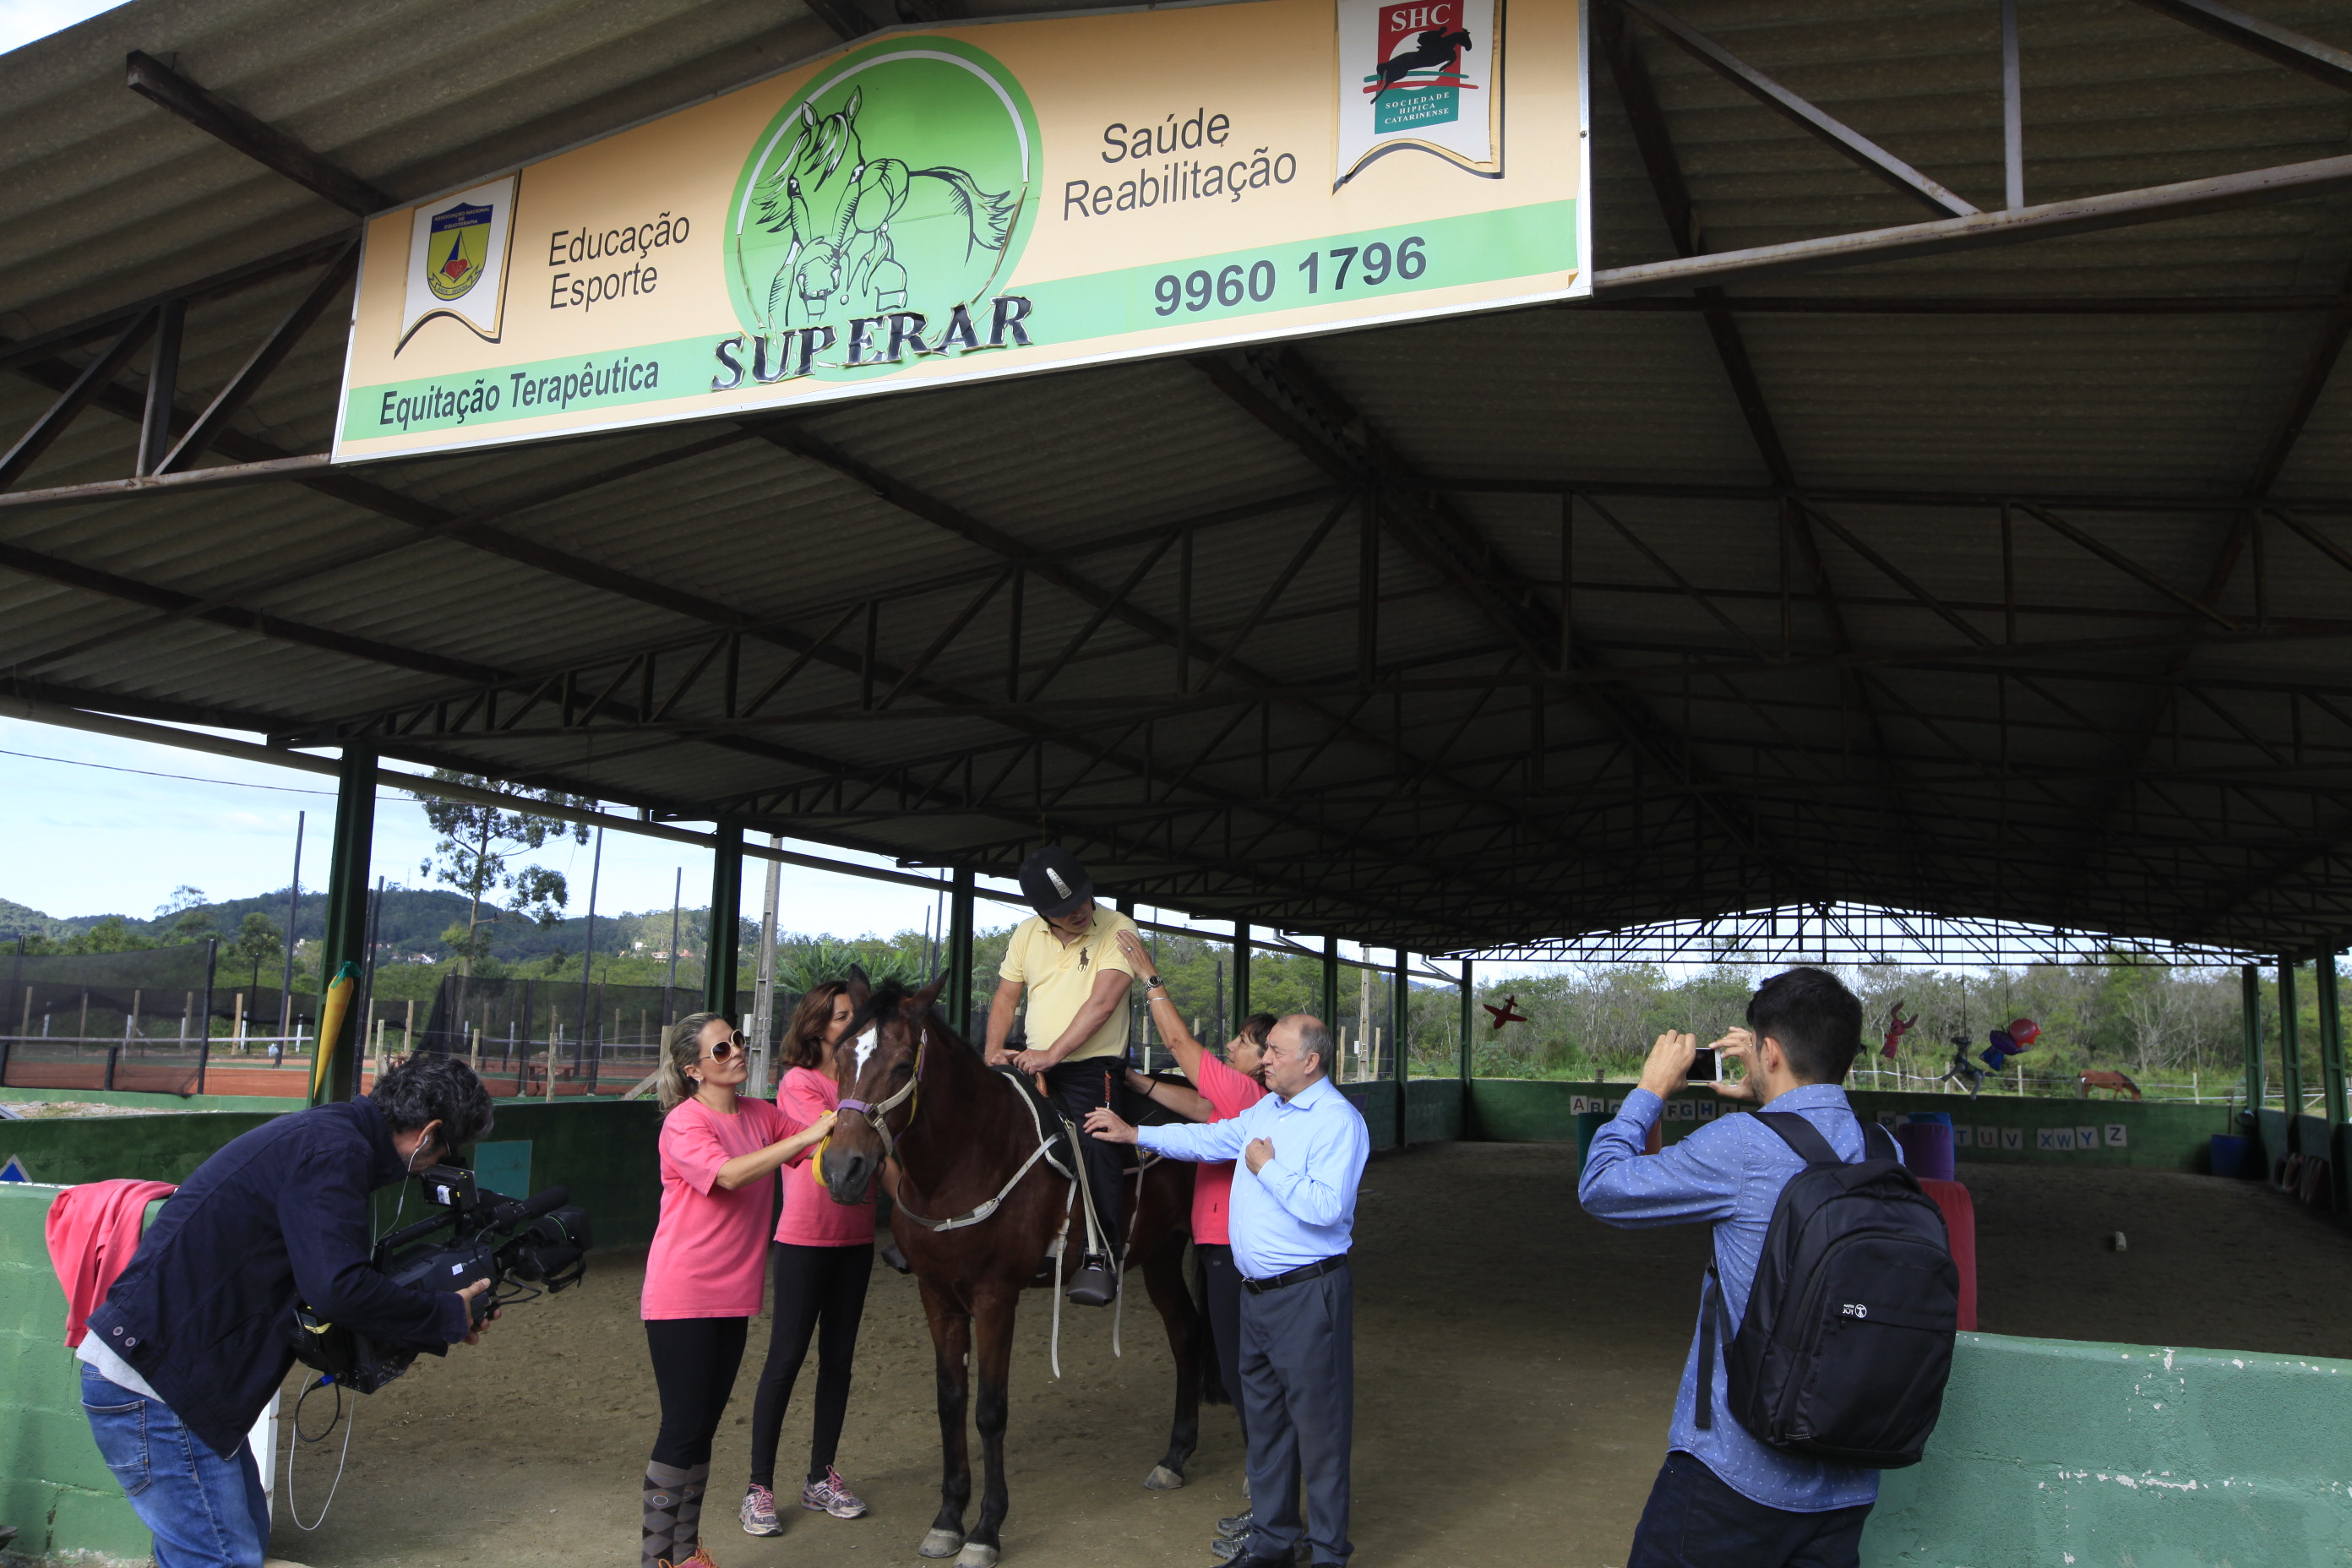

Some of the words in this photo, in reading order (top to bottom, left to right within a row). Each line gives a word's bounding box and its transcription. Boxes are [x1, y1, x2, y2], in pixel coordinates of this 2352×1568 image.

[1391, 3, 1451, 33] SHC
[1386, 91, 1450, 109] SOCIEDADE
[1385, 107, 1450, 125] CATARINENSE
[1101, 106, 1231, 164] Saúde
[1062, 146, 1298, 221] Reabilitação
[444, 219, 478, 230] EQUOTERAPIA
[466, 207, 491, 215] NACIONAL
[548, 210, 690, 267] Educação
[549, 261, 658, 313] Esporte
[1154, 259, 1277, 317] 9960
[1298, 236, 1427, 296] 1796
[709, 295, 1034, 391] SUPERAR
[379, 378, 501, 432] Equitação
[509, 357, 660, 410] Terapêutica
[1573, 1098, 1585, 1111] A
[1668, 1104, 1677, 1117] F
[1680, 1103, 1693, 1116] G
[1701, 1102, 1712, 1116] H
[1956, 1130, 1968, 1144] T
[1981, 1131, 1993, 1146] U
[2006, 1134, 2017, 1147] V
[2080, 1132, 2093, 1146] Y
[2109, 1127, 2122, 1141] Z
[1843, 1307, 1854, 1315] JOY
